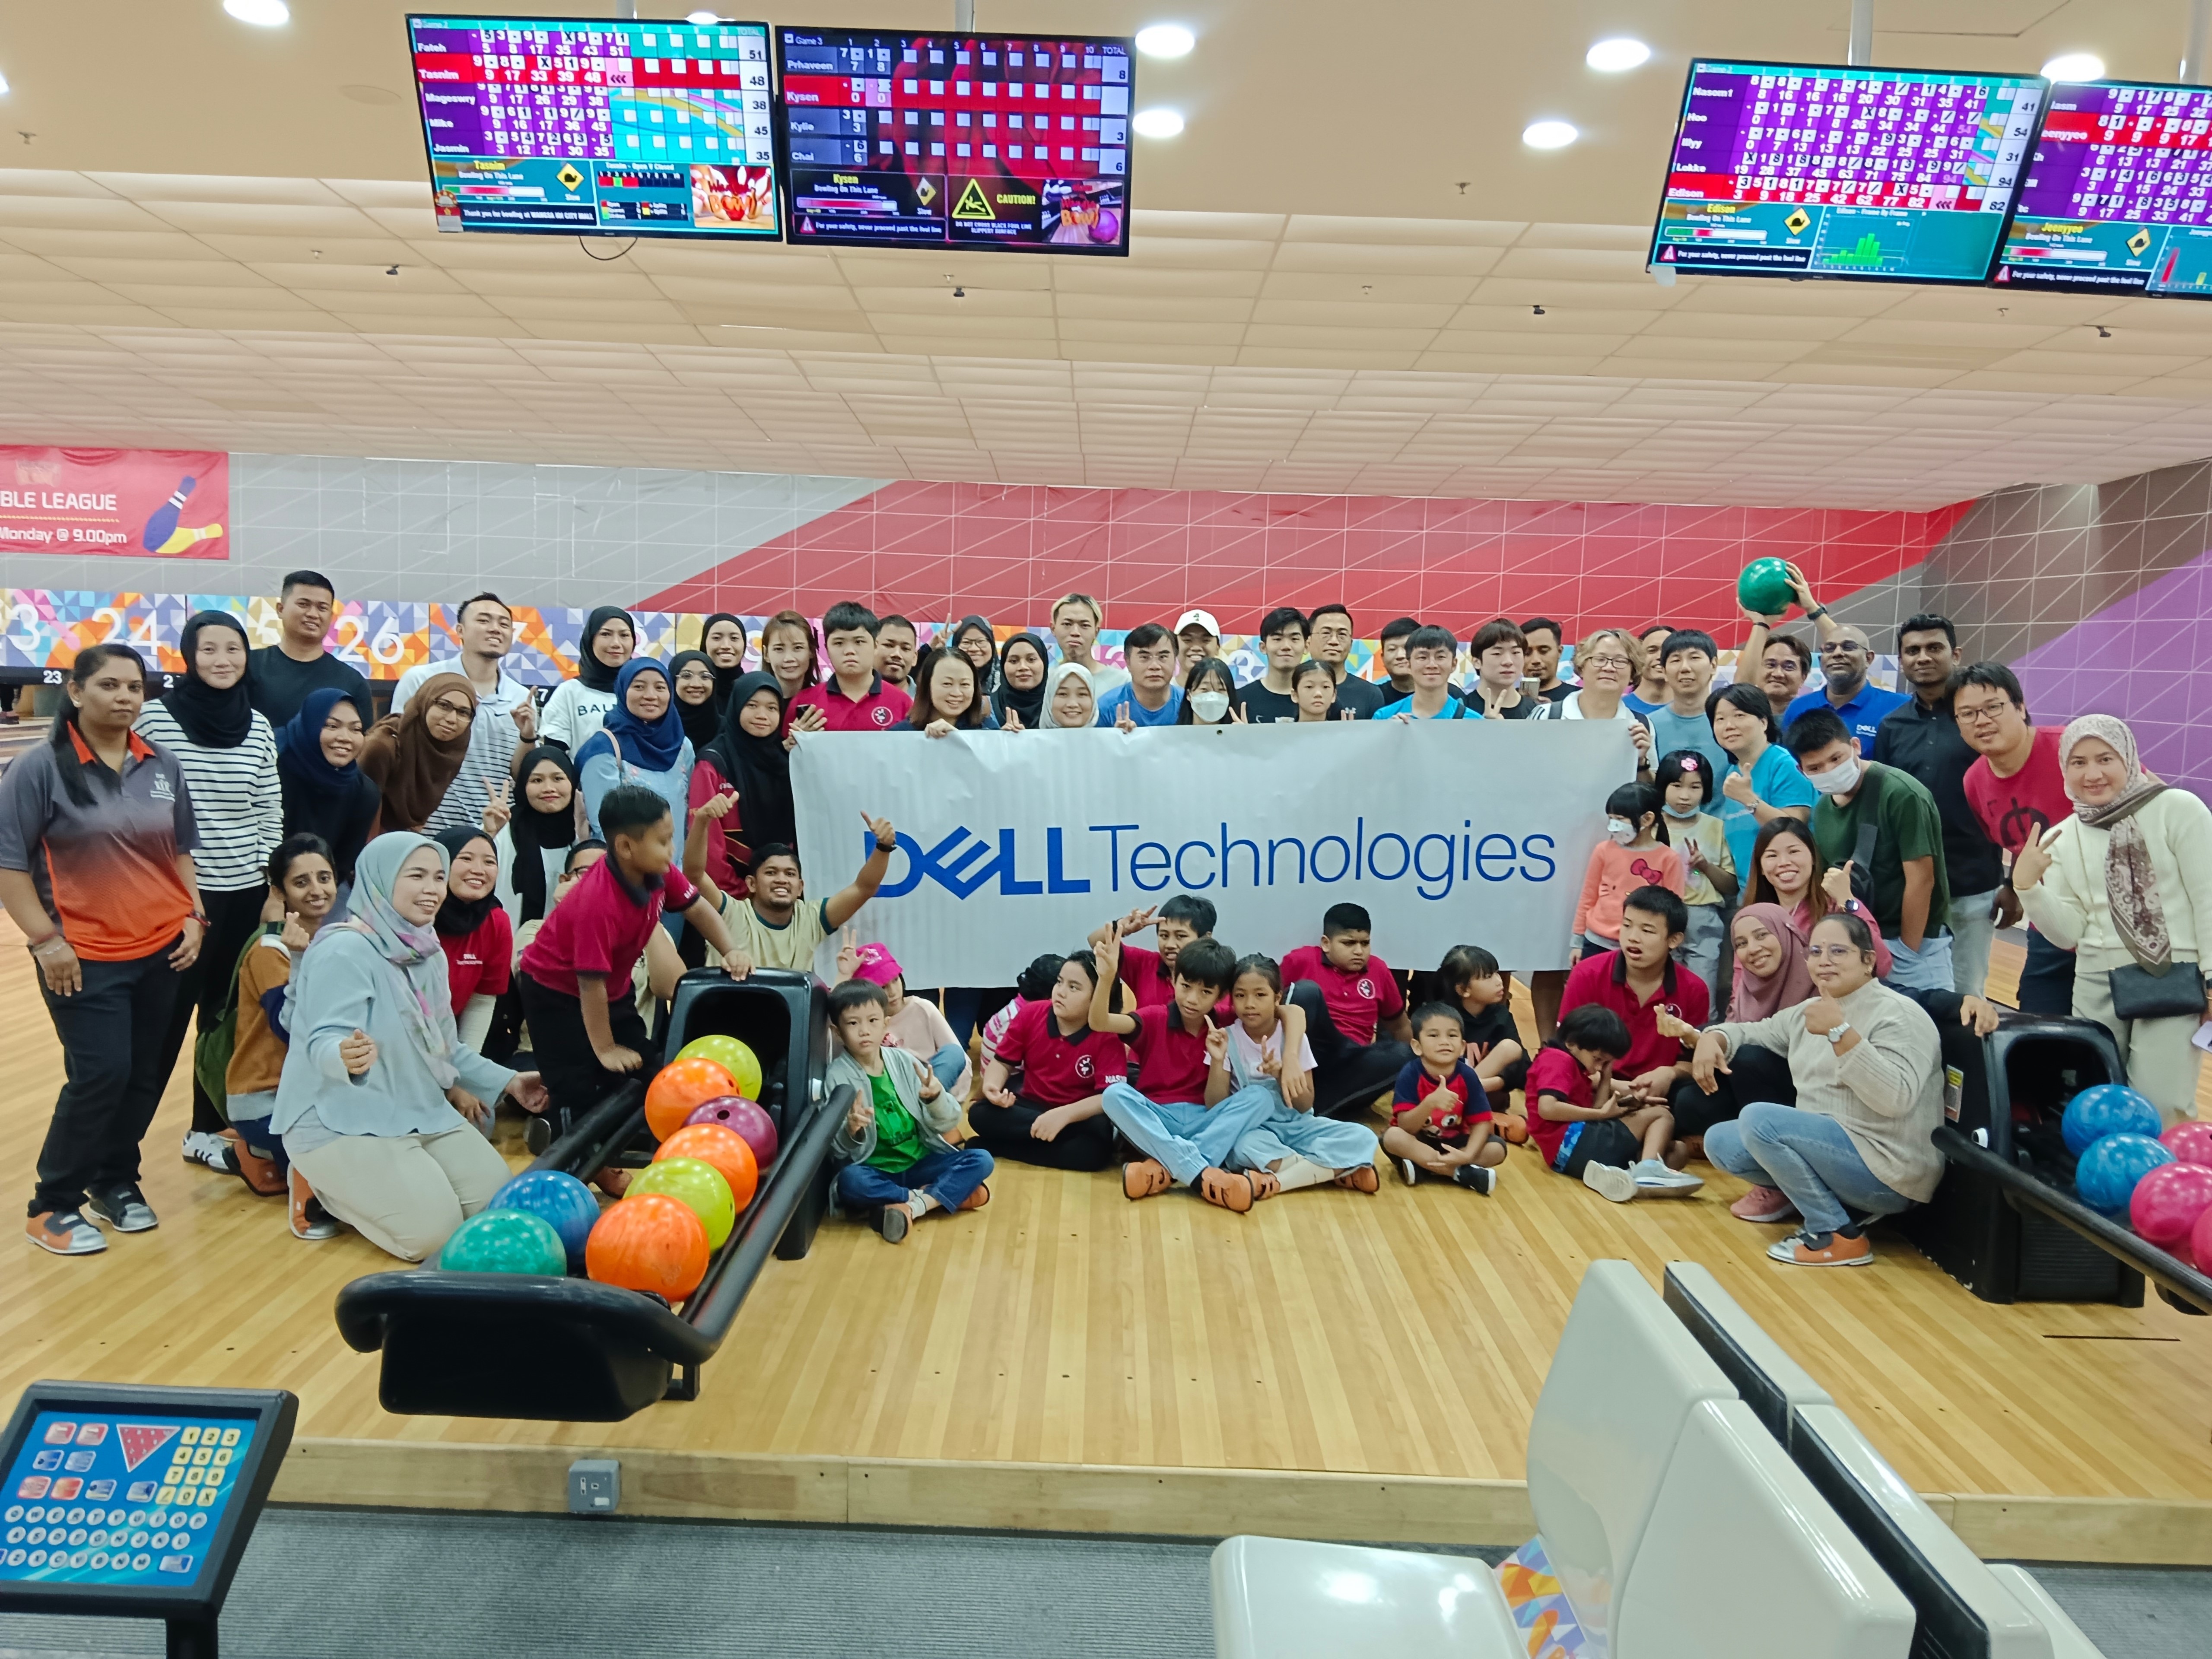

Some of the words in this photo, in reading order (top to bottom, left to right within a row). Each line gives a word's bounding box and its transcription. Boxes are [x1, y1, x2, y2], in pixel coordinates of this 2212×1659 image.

[418, 43, 447, 53] Fateh
[483, 43, 490, 53] 5
[509, 44, 518, 53] 8
[530, 45, 543, 54] 17
[556, 45, 571, 54] 35
[582, 46, 598, 56] 43
[610, 47, 623, 56] 51
[750, 51, 762, 59] 51
[795, 36, 817, 45] Game
[1102, 46, 1125, 55] TOTAL
[419, 69, 459, 80] Tasnim
[485, 70, 494, 79] 9
[505, 70, 520, 80] 17
[531, 72, 547, 81] 33
[558, 72, 574, 81] 39
[585, 73, 601, 83] 48
[750, 76, 765, 85] 48
[787, 60, 833, 70] Prhaveen
[850, 61, 858, 71] 7
[877, 62, 885, 72] 8
[1119, 70, 1125, 79] 8
[489, 94, 497, 103] 9
[510, 95, 523, 104] 17
[535, 95, 550, 104] 26
[562, 96, 577, 105] 29
[588, 97, 604, 105] 38
[786, 92, 819, 103] Kysen
[851, 92, 860, 102] 0
[877, 93, 885, 103] 0
[1693, 87, 1733, 97] Nasom1
[1758, 89, 1767, 99] 8
[1779, 90, 1794, 100] 16
[1806, 91, 1820, 101] 16
[1833, 93, 1847, 103] 16
[1858, 94, 1874, 104] 20
[1885, 95, 1900, 105] 30
[1911, 97, 1926, 106] 31
[1938, 98, 1953, 107] 35
[1964, 99, 1978, 108] 41
[2022, 103, 2035, 111] 41
[2114, 103, 2124, 113] 9
[2136, 105, 2153, 114] 17
[2162, 106, 2180, 116] 25
[2190, 107, 2208, 118] 32
[430, 118, 454, 127] Mike
[493, 119, 501, 128] 9
[513, 120, 527, 129] 16
[540, 120, 553, 129] 17
[565, 121, 580, 130] 36
[591, 122, 607, 131] 45
[853, 123, 861, 132] 3
[1117, 133, 1123, 141] 3
[2014, 127, 2028, 137] 54
[2042, 130, 2088, 141] eenyyeo
[2104, 130, 2115, 141] 9
[2131, 131, 2142, 142] 9
[2159, 133, 2171, 144] 9
[2180, 135, 2198, 146] 17
[434, 144, 469, 153] Jasmin
[497, 145, 504, 153] 3
[517, 146, 531, 154] 12
[542, 146, 555, 155] 21
[569, 147, 583, 156] 30
[595, 147, 610, 156] 35
[2006, 153, 2019, 161] 31
[854, 154, 862, 162] 6
[1116, 162, 1122, 171] 6
[833, 174, 858, 184] Kysen
[1676, 163, 1706, 172] Lokke
[1999, 177, 2012, 187] 94
[997, 194, 1036, 205] CAUTION!
[1668, 188, 1704, 198] Edison
[1733, 189, 1742, 199] 3
[1760, 191, 1769, 200] 9
[1780, 191, 1795, 201] 18
[1803, 193, 1821, 203] 25
[1830, 194, 1847, 204] 42
[1856, 195, 1872, 205] 62
[1883, 196, 1900, 206] 77
[1908, 197, 1925, 207] 82
[1707, 203, 1735, 213] Edison
[0, 491, 36, 508] BLE
[42, 492, 117, 511] LEAGUE
[0, 527, 53, 544] Monday
[57, 528, 69, 541] @
[73, 529, 127, 545] 9.00pm
[334, 615, 404, 664] 26
[44, 671, 62, 684] 23
[864, 824, 1090, 900] DELL
[1089, 817, 1556, 900] Technologies
